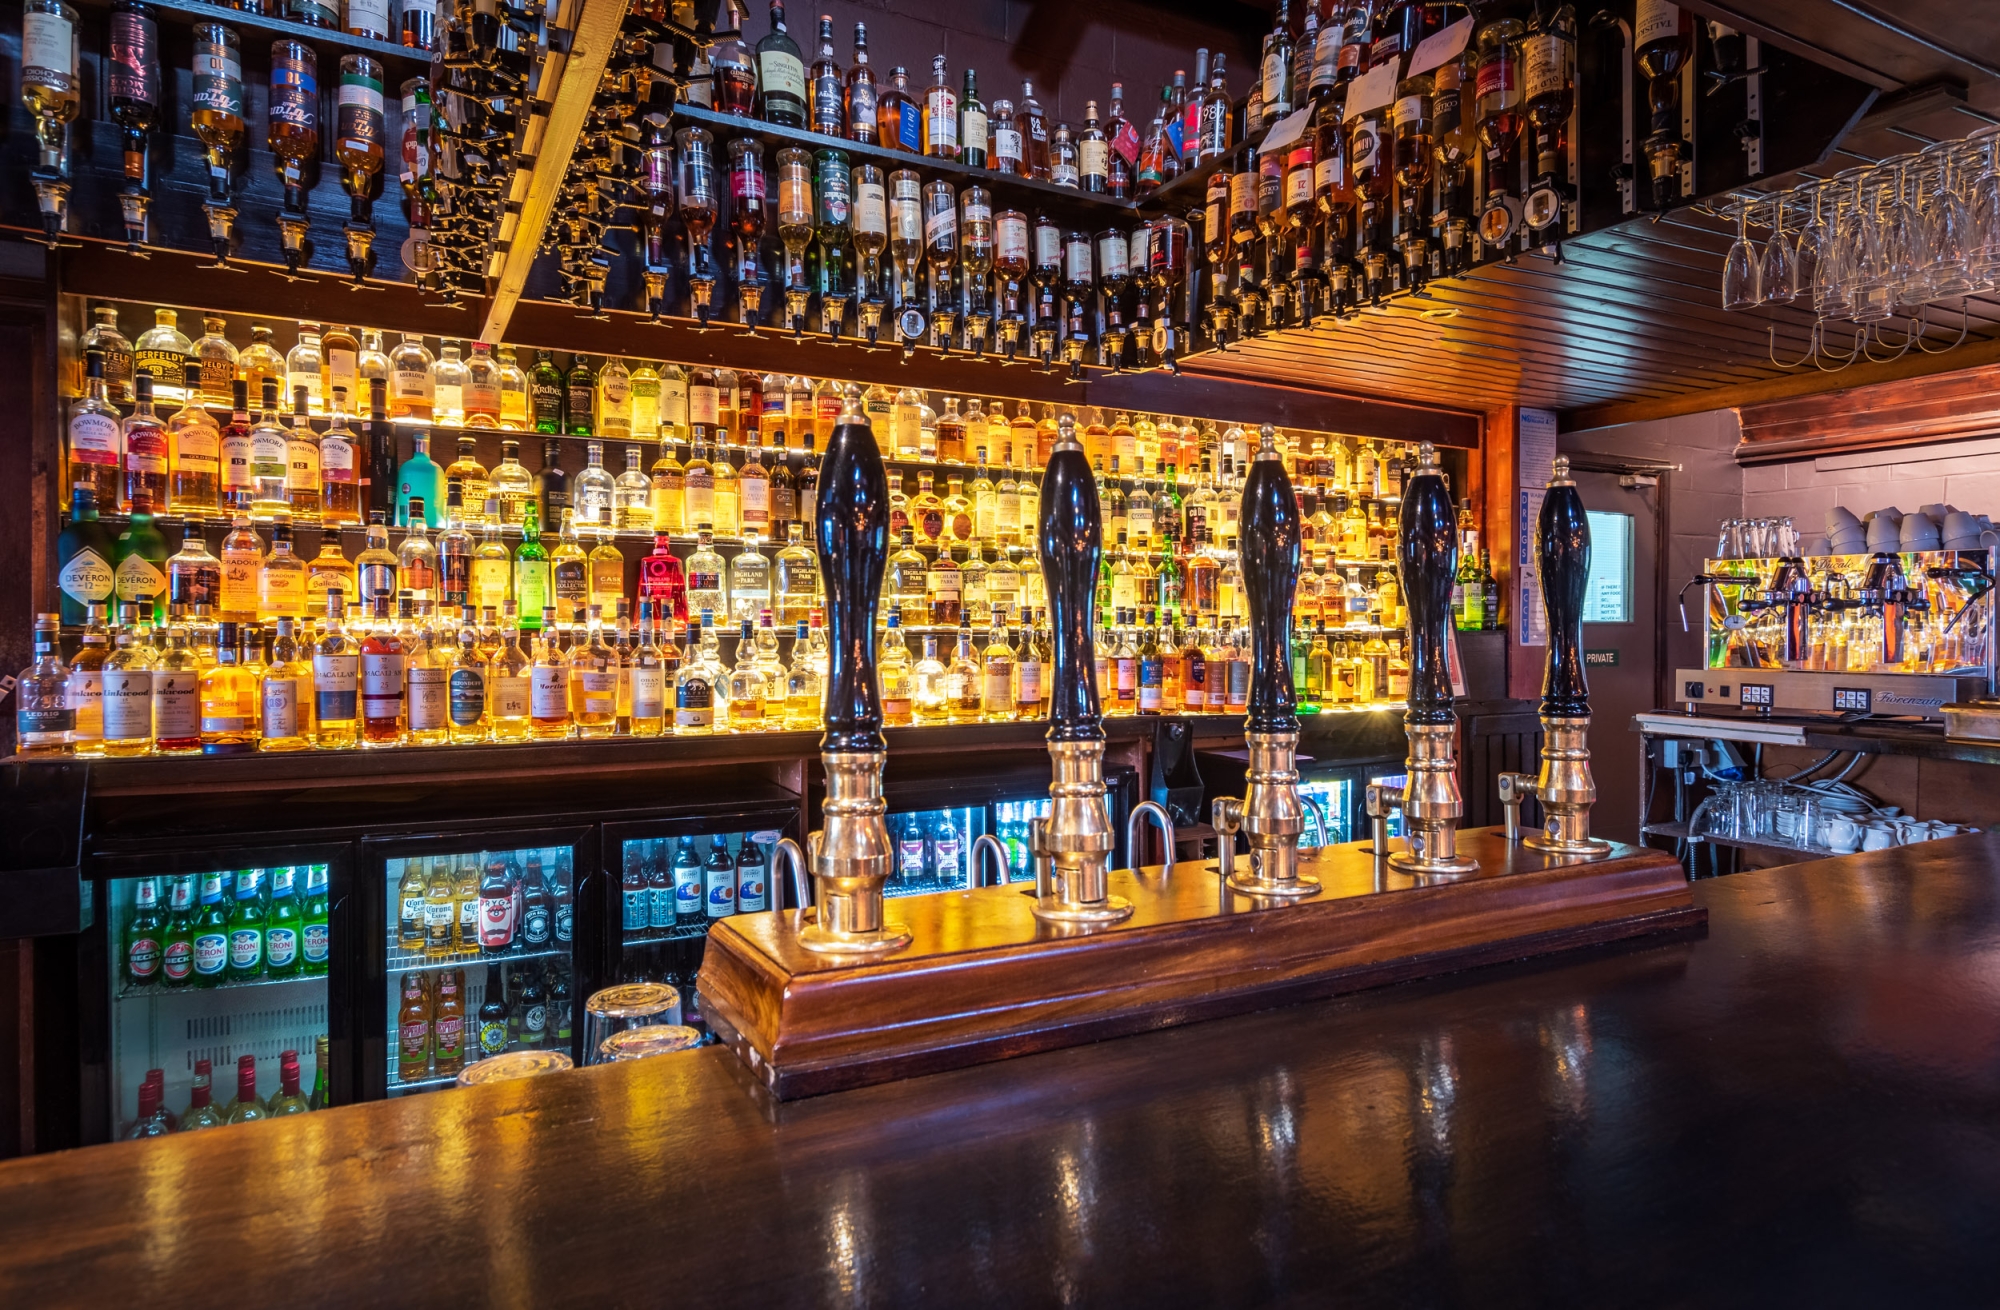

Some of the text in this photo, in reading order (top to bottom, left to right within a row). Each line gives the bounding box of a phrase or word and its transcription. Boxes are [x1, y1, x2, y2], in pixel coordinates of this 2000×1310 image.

[1636, 20, 1672, 39] TALISKE
[210, 57, 223, 70] 10
[23, 75, 69, 90] CONNOISSE
[287, 72, 300, 85] 18
[193, 93, 239, 112] Arran
[270, 106, 314, 125] Arran
[1298, 180, 1307, 190] 21
[136, 350, 186, 363] ABERFELDY
[74, 418, 117, 433] BOWMORE
[131, 431, 168, 444] BOWMORE
[184, 430, 219, 441] BOWMORE
[222, 441, 249, 450] BOWMO
[65, 574, 111, 584] DEVERON
[734, 571, 763, 579] HIGHLAND
[84, 582, 94, 590] 12
[1522, 593, 1530, 638] CCTV
[1586, 653, 1615, 664] PRIVATE
[380, 681, 389, 689] 25
[103, 688, 149, 698] Linkwood
[25, 710, 60, 718] LEDAIG
[431, 912, 447, 920] Extra
[230, 941, 259, 952] PERONI
[266, 940, 293, 950] PERONI
[304, 937, 328, 946] PERON
[195, 945, 225, 956] PERONI
